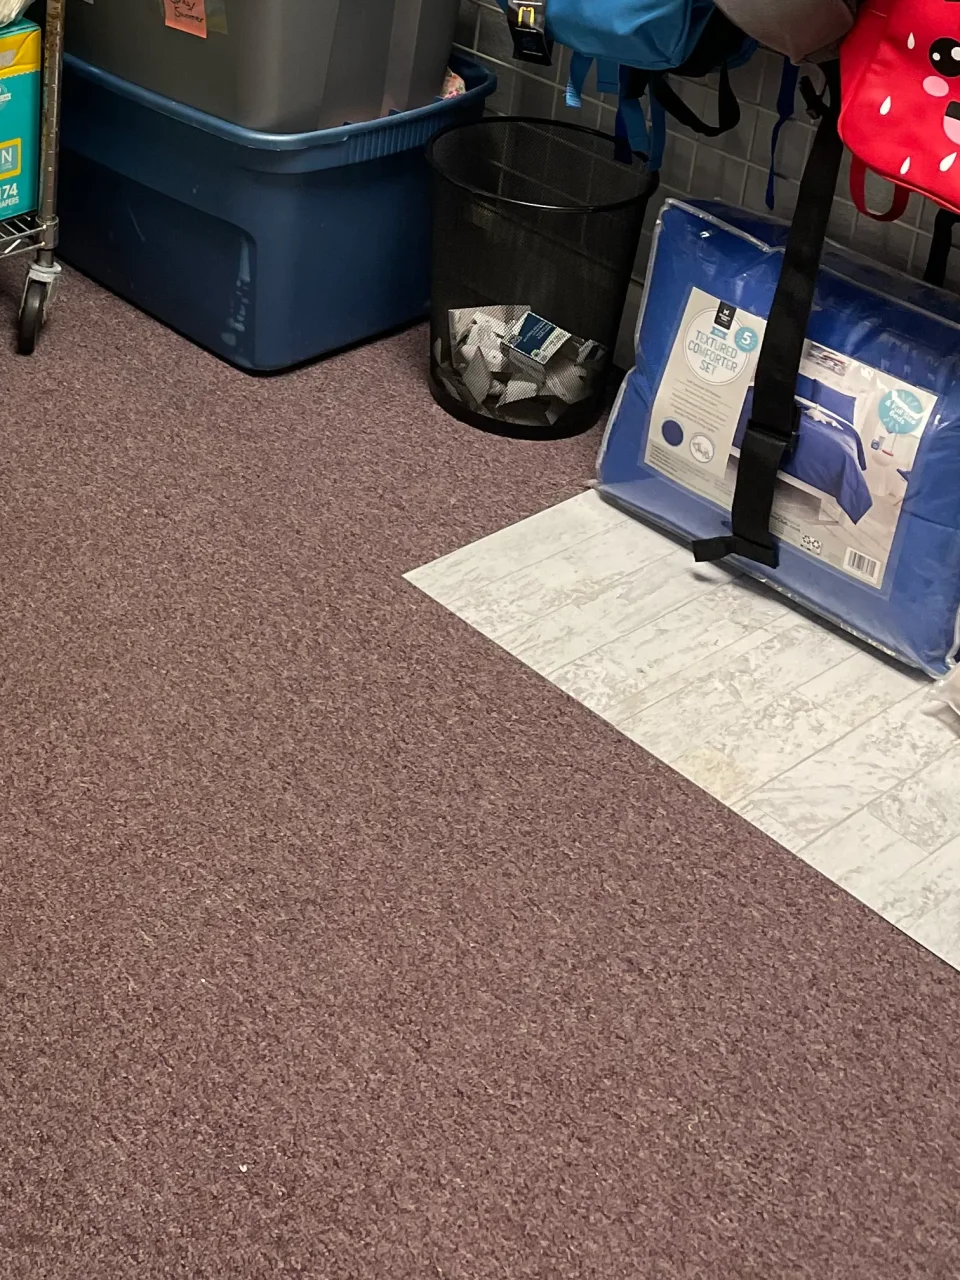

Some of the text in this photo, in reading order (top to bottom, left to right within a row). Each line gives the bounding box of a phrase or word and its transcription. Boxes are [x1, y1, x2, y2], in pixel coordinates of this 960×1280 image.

[1, 147, 13, 164] N
[695, 329, 753, 359] TEXTURED 5
[687, 340, 738, 374] COMFORTER
[699, 359, 718, 377] SET
